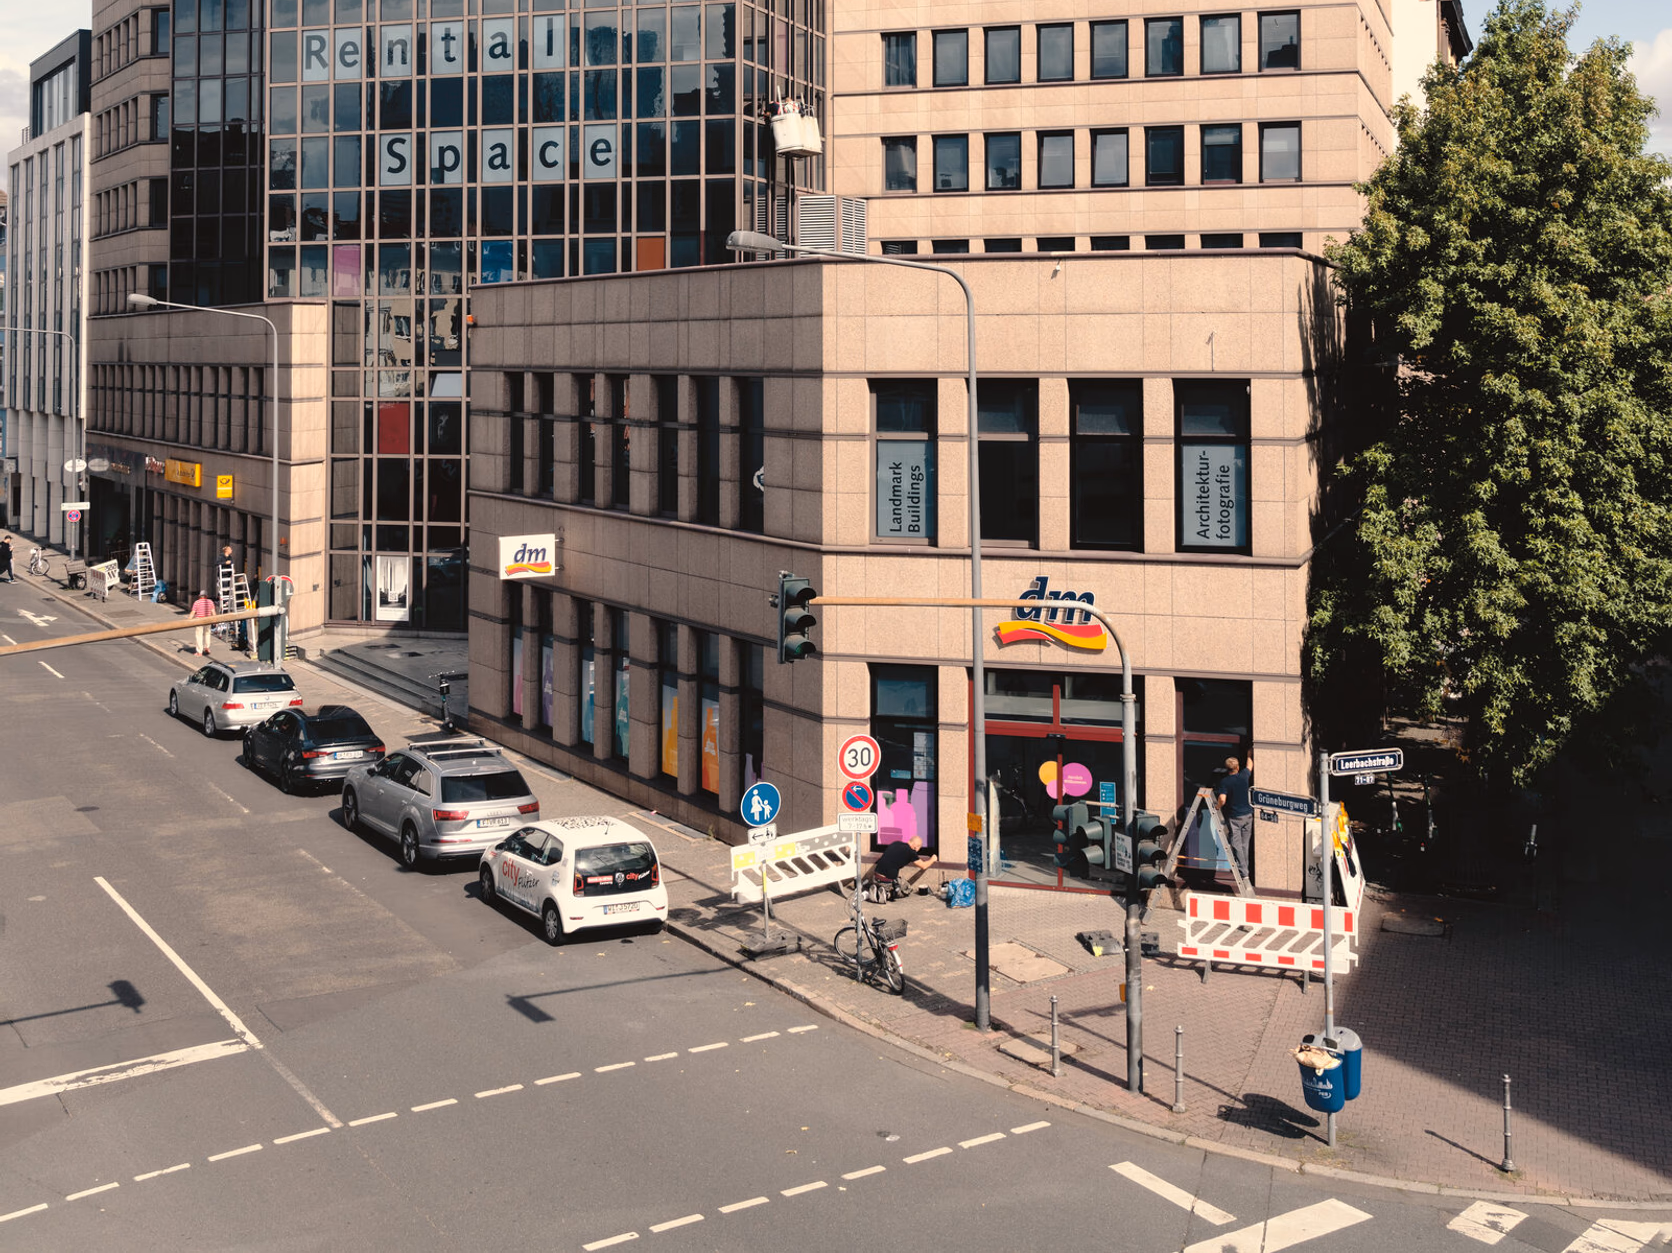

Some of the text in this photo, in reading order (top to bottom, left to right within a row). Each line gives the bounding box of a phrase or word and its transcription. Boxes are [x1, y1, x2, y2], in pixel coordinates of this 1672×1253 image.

[304, 17, 554, 70] Rental
[387, 137, 613, 174] Space
[889, 461, 903, 533] Landmark
[908, 464, 923, 533] Buildings
[1196, 449, 1210, 540] Architektur-
[1217, 464, 1233, 540] fotografie
[513, 543, 547, 564] dm
[1015, 576, 1095, 622] dm
[848, 747, 871, 768] 30
[1341, 755, 1395, 770] Leerbachstraße
[1258, 793, 1309, 813] Grüneburgweg
[502, 857, 520, 887] city
[626, 872, 639, 881] city
